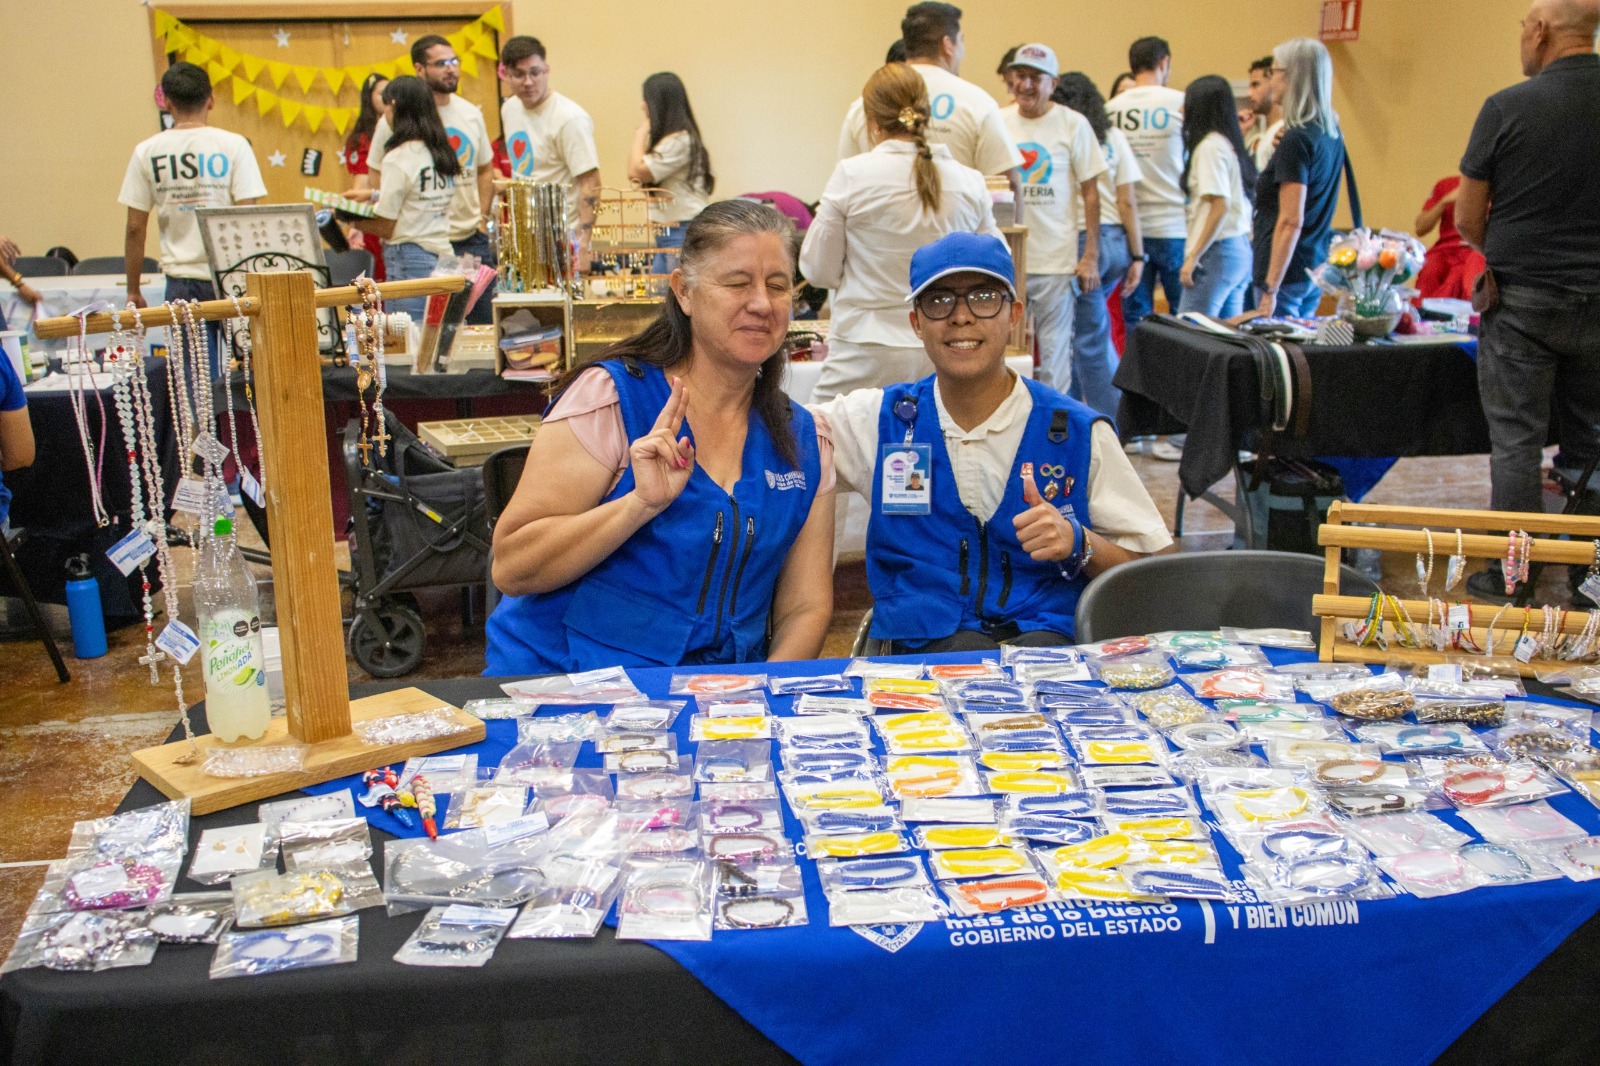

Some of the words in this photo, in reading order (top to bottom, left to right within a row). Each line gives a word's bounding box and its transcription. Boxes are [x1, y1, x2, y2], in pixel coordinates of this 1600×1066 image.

[1107, 107, 1169, 131] ISIO
[151, 153, 229, 183] FISIO
[1024, 186, 1055, 197] FERIA
[945, 913, 1004, 930] más
[1012, 911, 1047, 924] de
[1053, 908, 1082, 921] lo
[1087, 903, 1178, 918] bueno
[1227, 906, 1240, 929] Y
[1245, 904, 1288, 928] BIEN
[949, 924, 1056, 947] GOBIERNO
[1061, 921, 1101, 938] DEL
[1105, 916, 1181, 936] ESTADO
